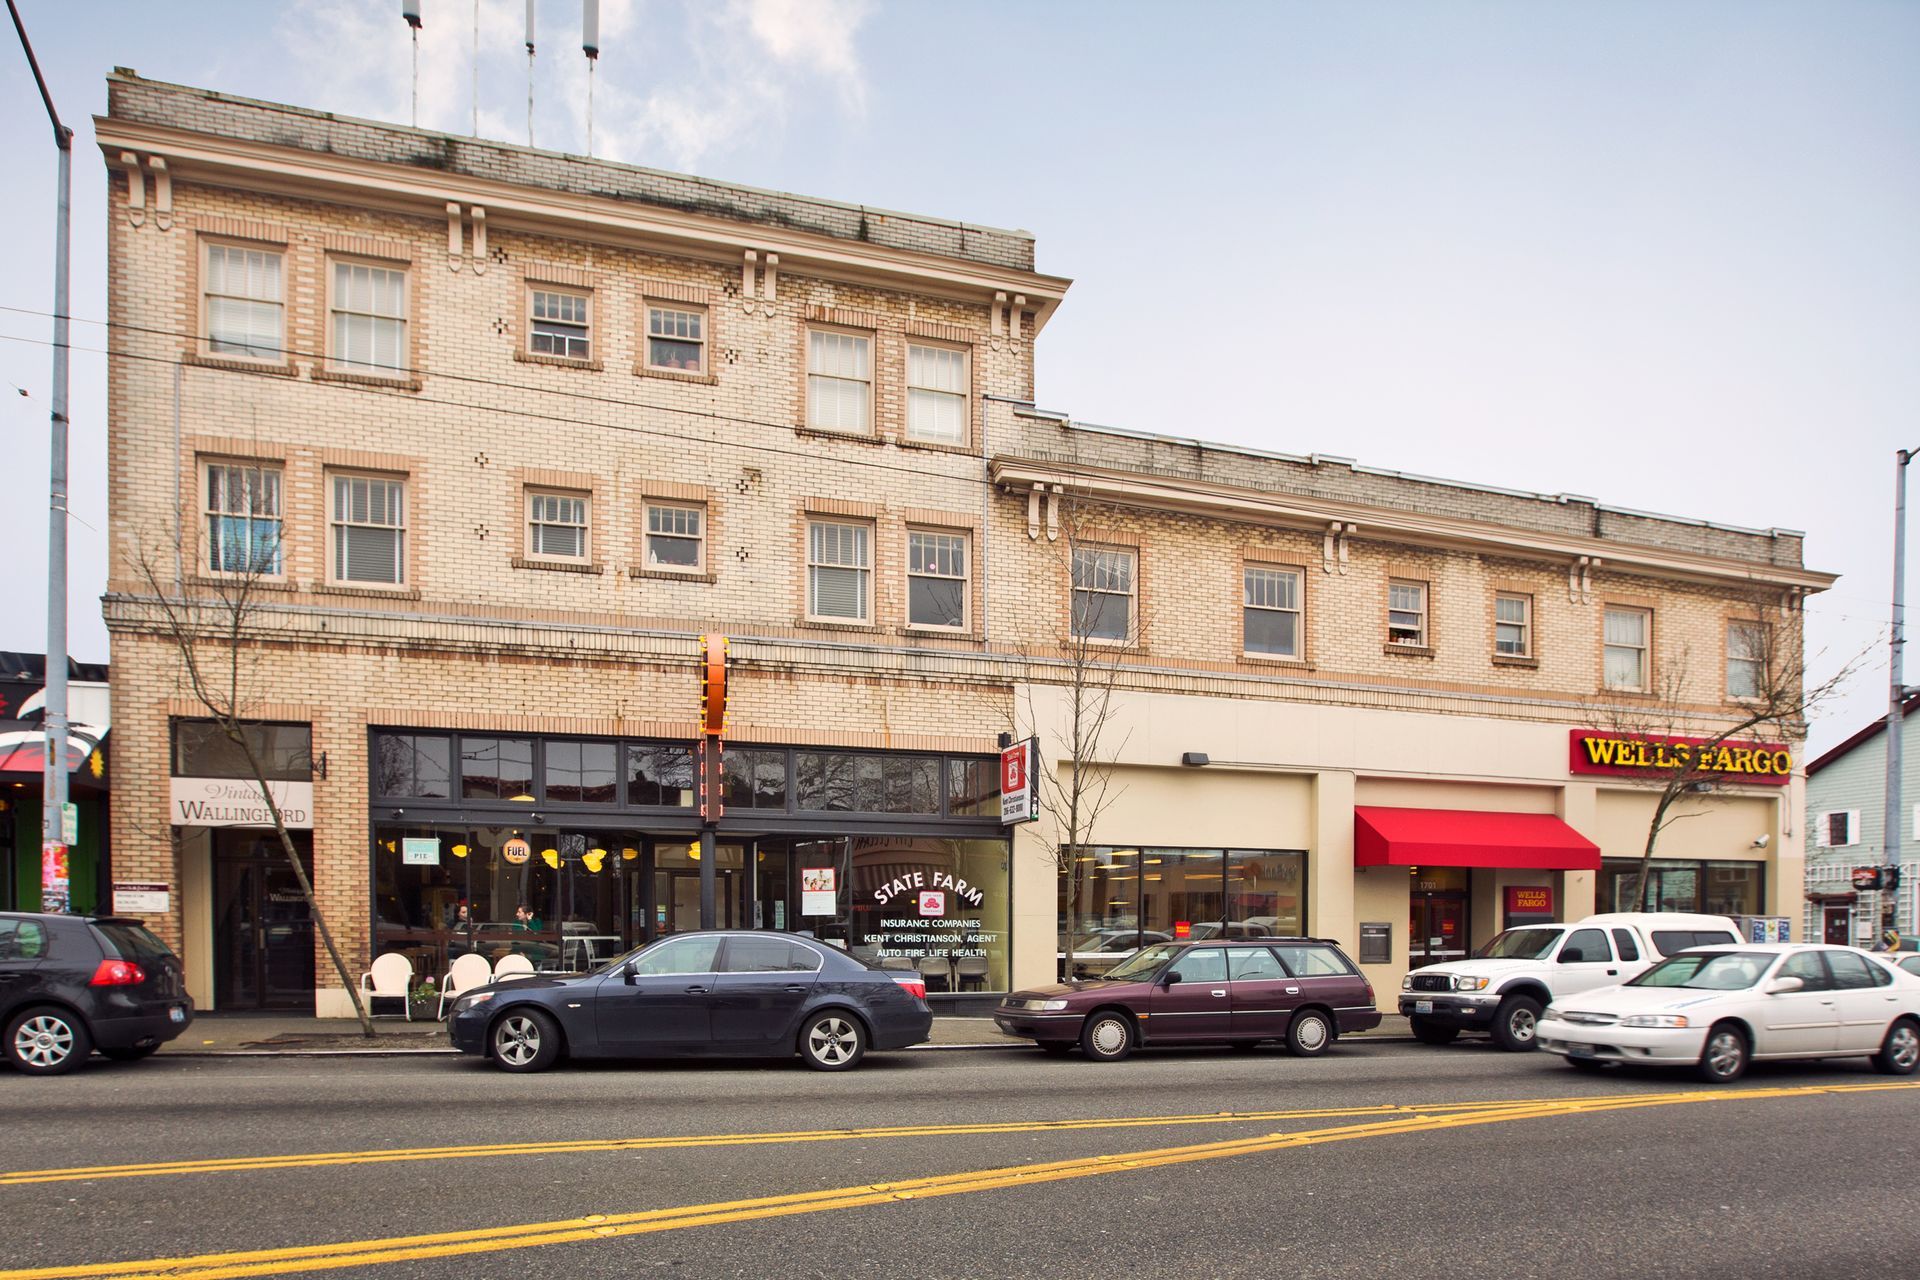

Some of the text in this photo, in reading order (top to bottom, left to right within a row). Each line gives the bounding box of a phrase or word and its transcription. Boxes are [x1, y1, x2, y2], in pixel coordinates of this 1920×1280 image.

[1584, 737, 1793, 775] WELLS FARGO
[205, 783, 274, 805] Vintag
[507, 846, 527, 857] FUEL
[874, 871, 983, 907] STATE FARM
[1420, 881, 1437, 889] 1701
[1516, 891, 1546, 899] WELLS
[1517, 899, 1546, 907] FARGO
[880, 919, 981, 928] INSURANCE COMPANIES
[864, 934, 998, 943] KENT CHRISTIANSON, AGENT
[877, 949, 987, 957] AUTO FIRE LIFE HEALTH
